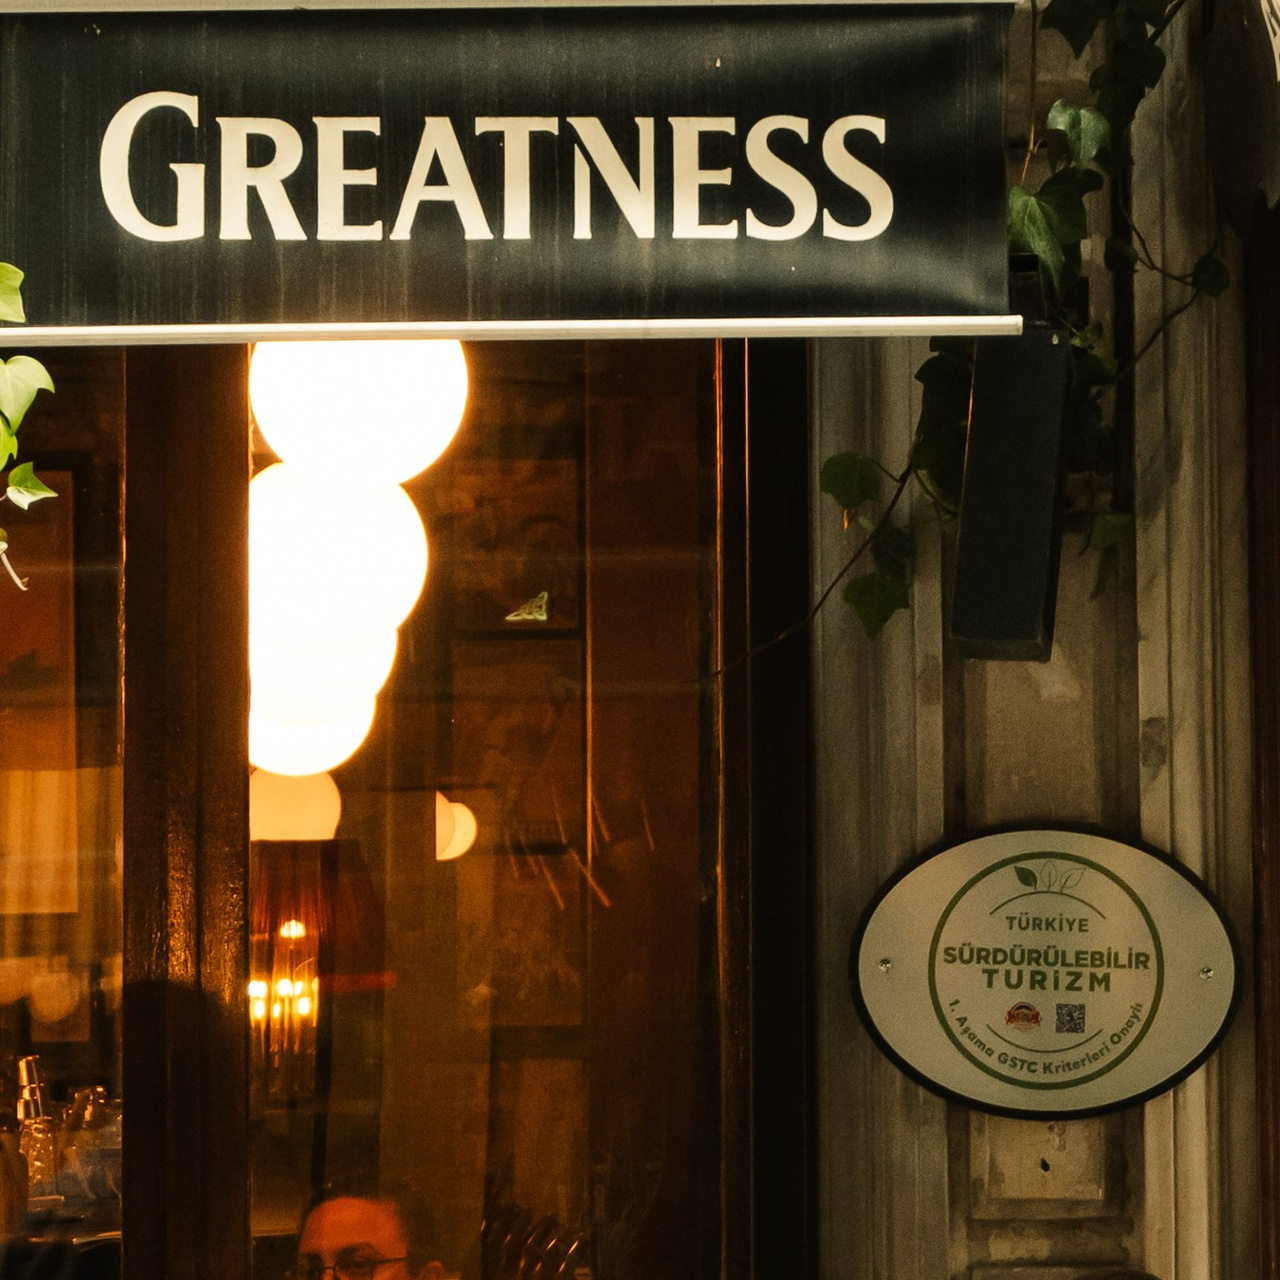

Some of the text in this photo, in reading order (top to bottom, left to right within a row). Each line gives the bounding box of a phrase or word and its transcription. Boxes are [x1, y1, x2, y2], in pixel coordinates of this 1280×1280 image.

[1006, 912, 1089, 933] TÜRKİYE
[943, 942, 1150, 969] SÜRDÜRÜLEBİLİR
[949, 998, 1144, 1074] 1. Aşama GSTC Kriterleri Onaylı
